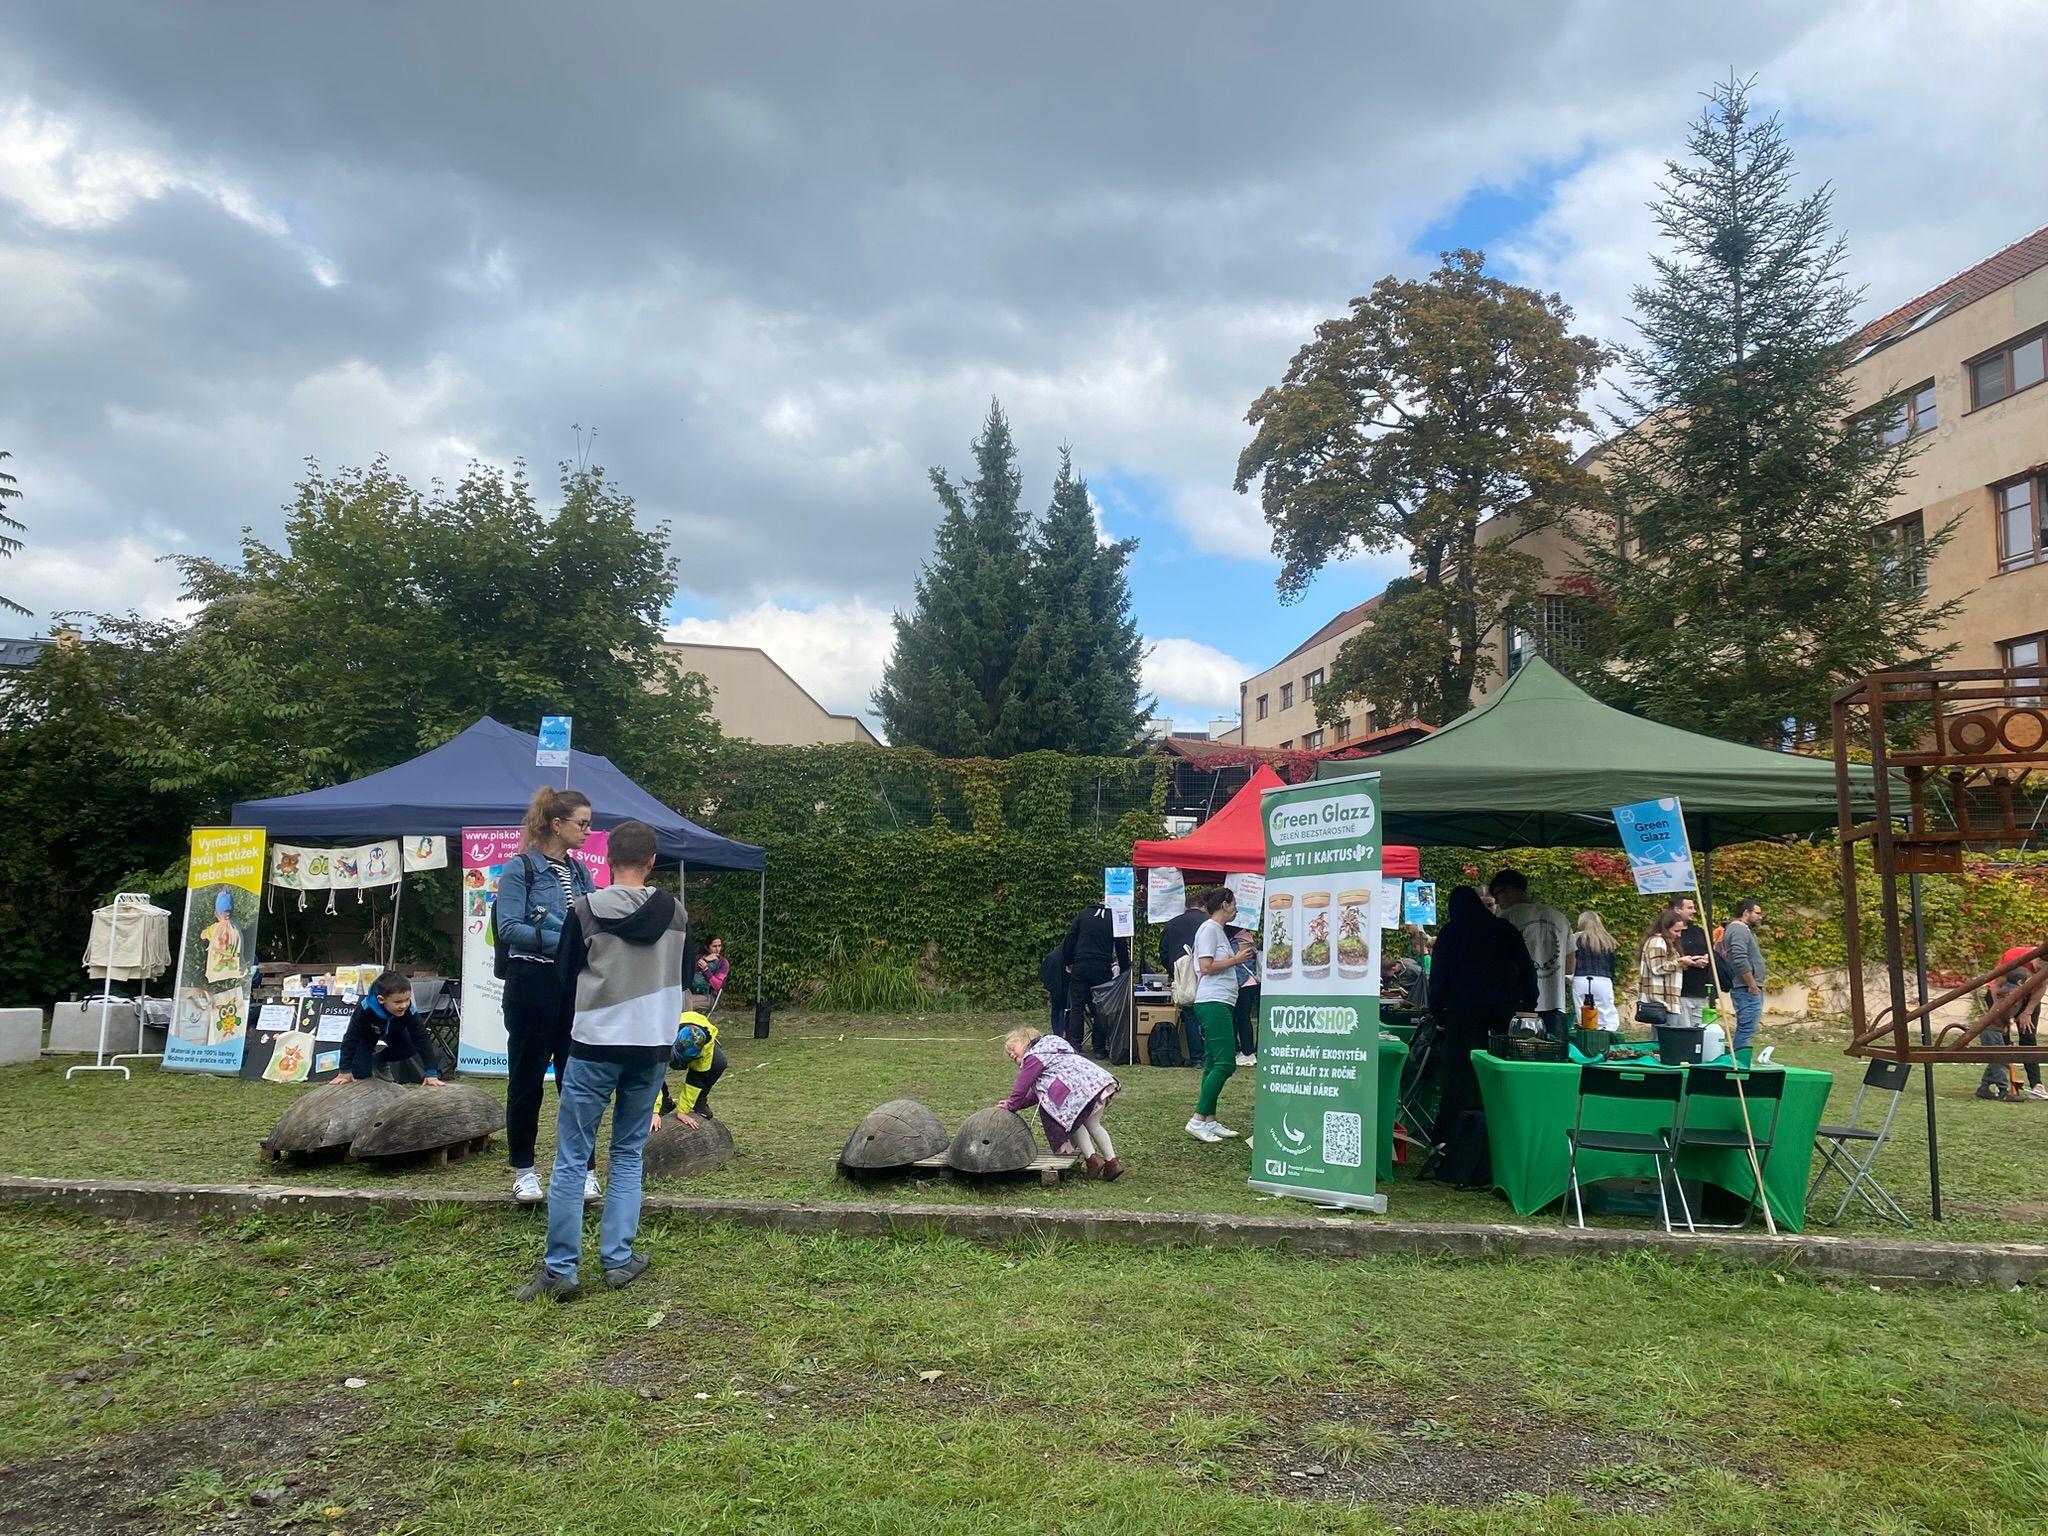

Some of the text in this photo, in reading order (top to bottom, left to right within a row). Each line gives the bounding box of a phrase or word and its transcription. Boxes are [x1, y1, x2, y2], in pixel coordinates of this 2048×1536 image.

[1272, 803, 1370, 830] Green Glazz
[1634, 820, 1670, 832] Green
[199, 831, 252, 851] Vymaluj si
[465, 830, 521, 841] www.piskoh
[1279, 830, 1300, 842] ZELEŇ
[1640, 832, 1671, 843] Glazz
[190, 852, 213, 868] svůj
[576, 850, 605, 865] svou
[1270, 851, 1292, 869] UMŘE
[1295, 852, 1305, 866] TI
[1307, 851, 1311, 865] I
[194, 863, 254, 883] nebo tašku
[1273, 1009, 1354, 1031] WORKSHOP
[459, 1055, 508, 1067] www.pisko
[1270, 1045, 1367, 1061] SOBĚSTAČNÝ EKOSYSTÉM
[1270, 1062, 1294, 1076] STAČÍ
[1295, 1064, 1317, 1077] ZALÍT
[1331, 1065, 1356, 1079] ROČNĚ
[1269, 1081, 1339, 1097] ORIGINÁLNÍ DÁREK
